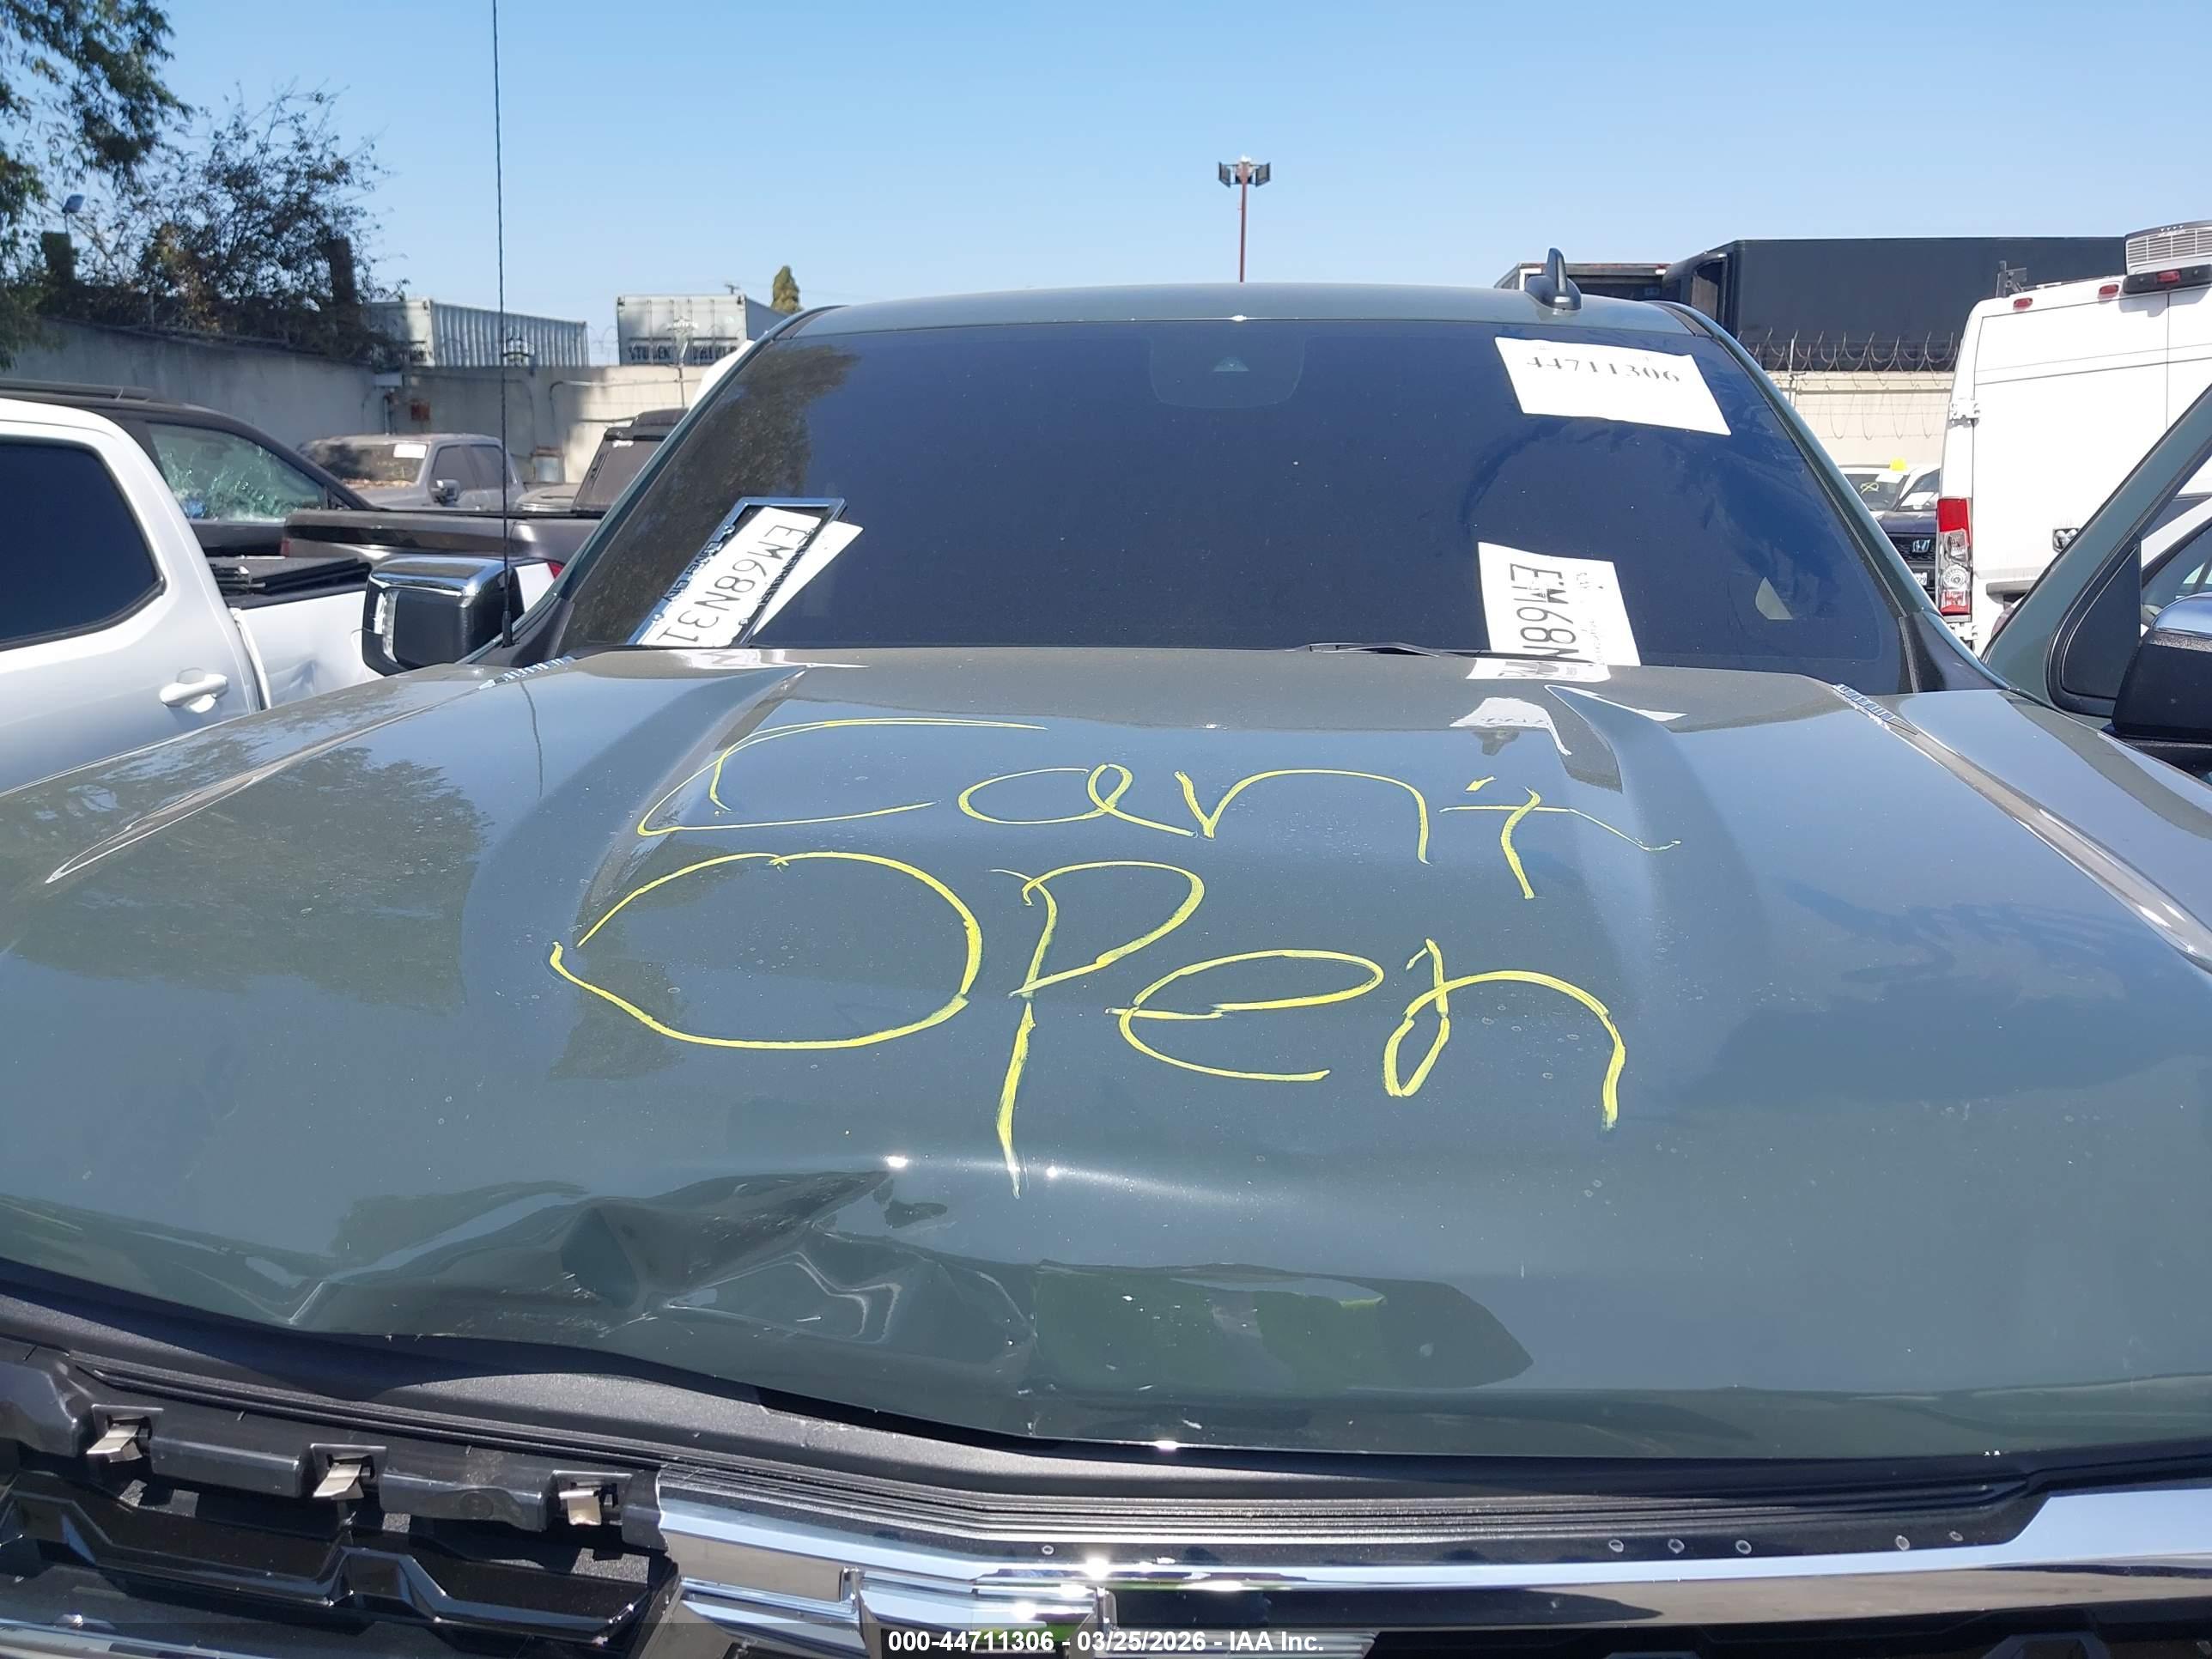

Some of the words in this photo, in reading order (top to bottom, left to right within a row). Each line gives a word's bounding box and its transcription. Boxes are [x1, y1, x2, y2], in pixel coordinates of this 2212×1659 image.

[1525, 356, 1682, 385] 44711306
[684, 539, 725, 575] Culver
[656, 524, 813, 642] EM68N31
[662, 578, 691, 603] City
